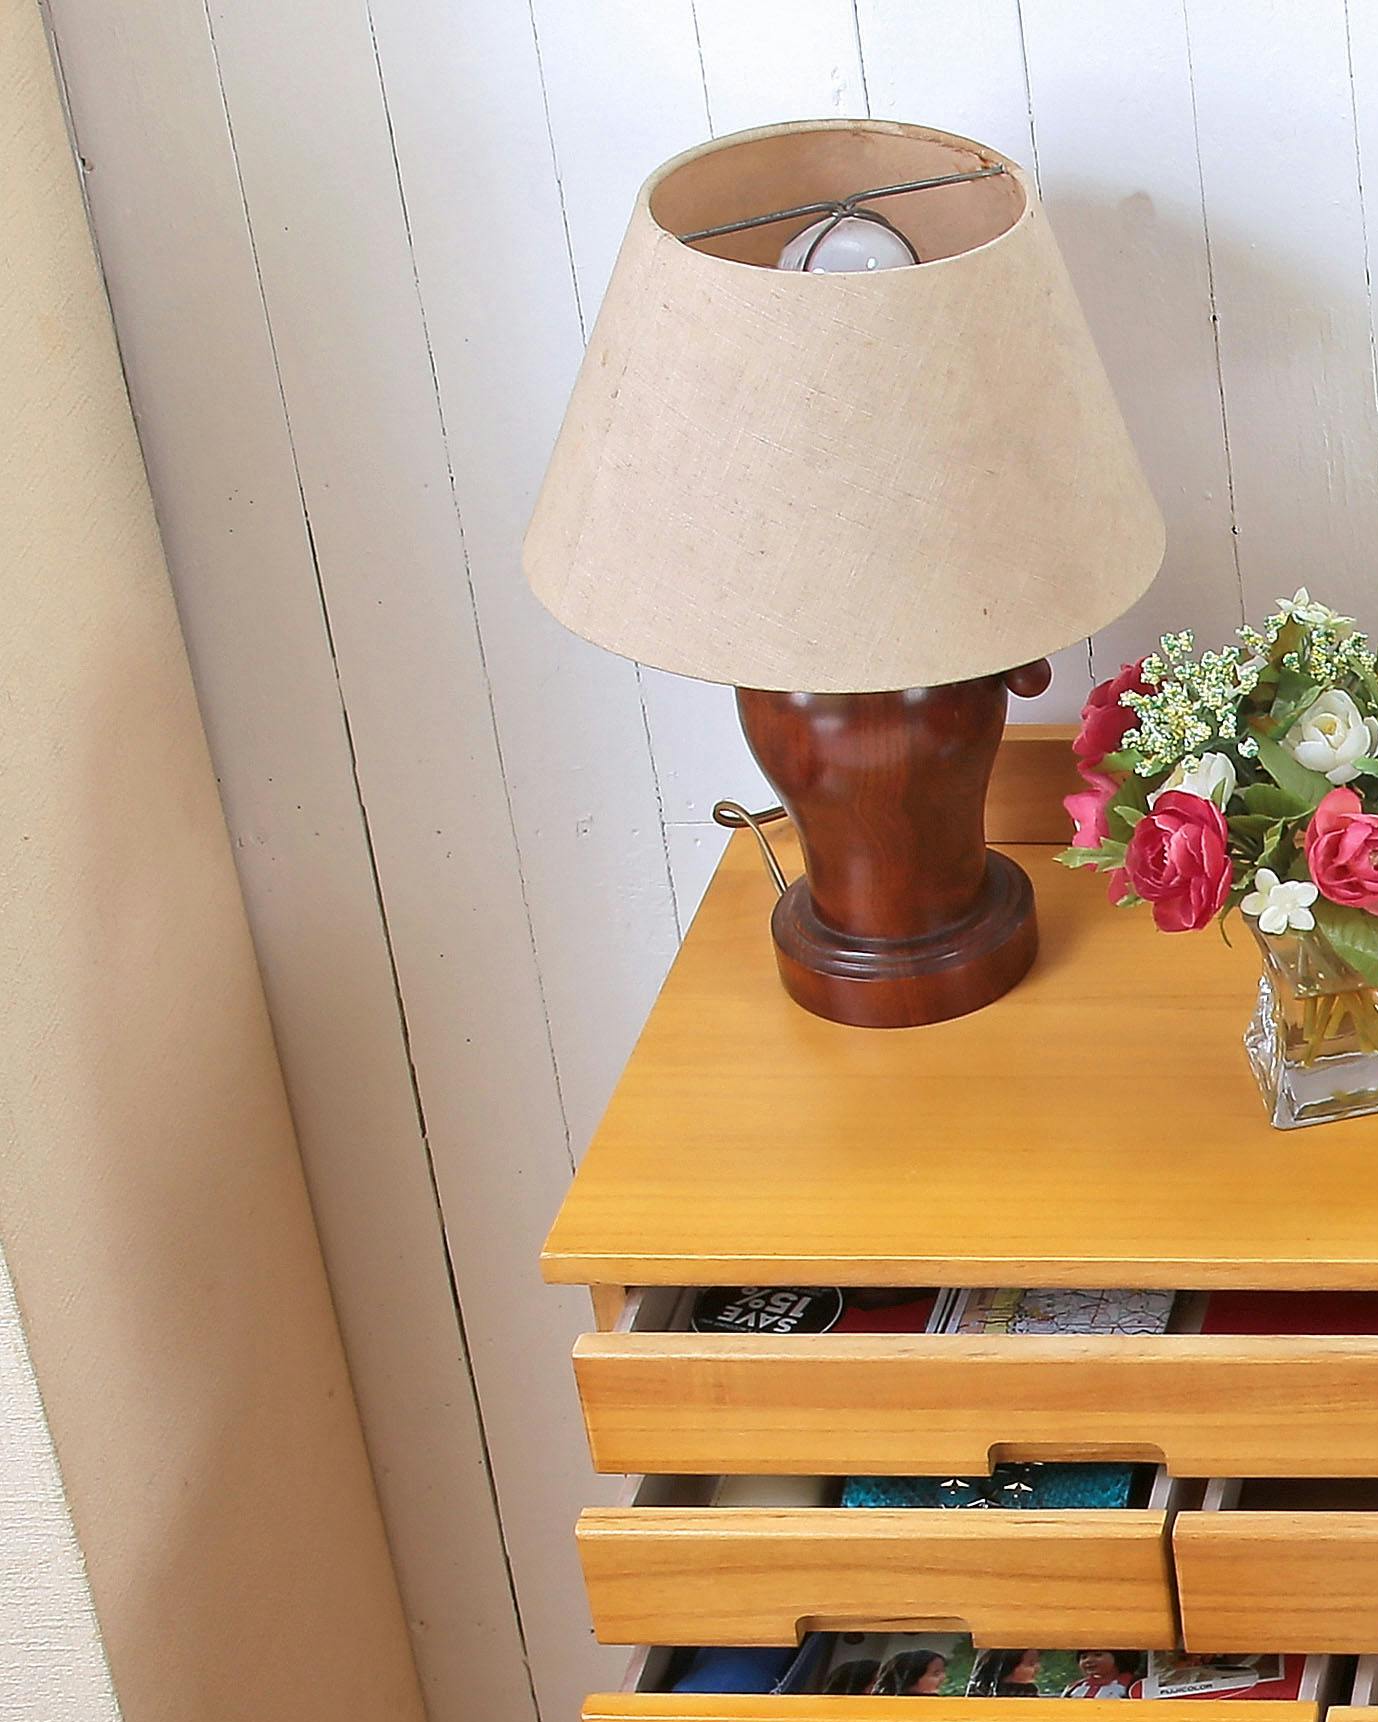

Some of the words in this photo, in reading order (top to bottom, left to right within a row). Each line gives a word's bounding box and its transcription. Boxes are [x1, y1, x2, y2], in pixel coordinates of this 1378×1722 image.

[735, 1287, 812, 1318] 15%
[717, 1305, 798, 1333] SAVE
[1160, 1683, 1214, 1696] FUJICOLOR
